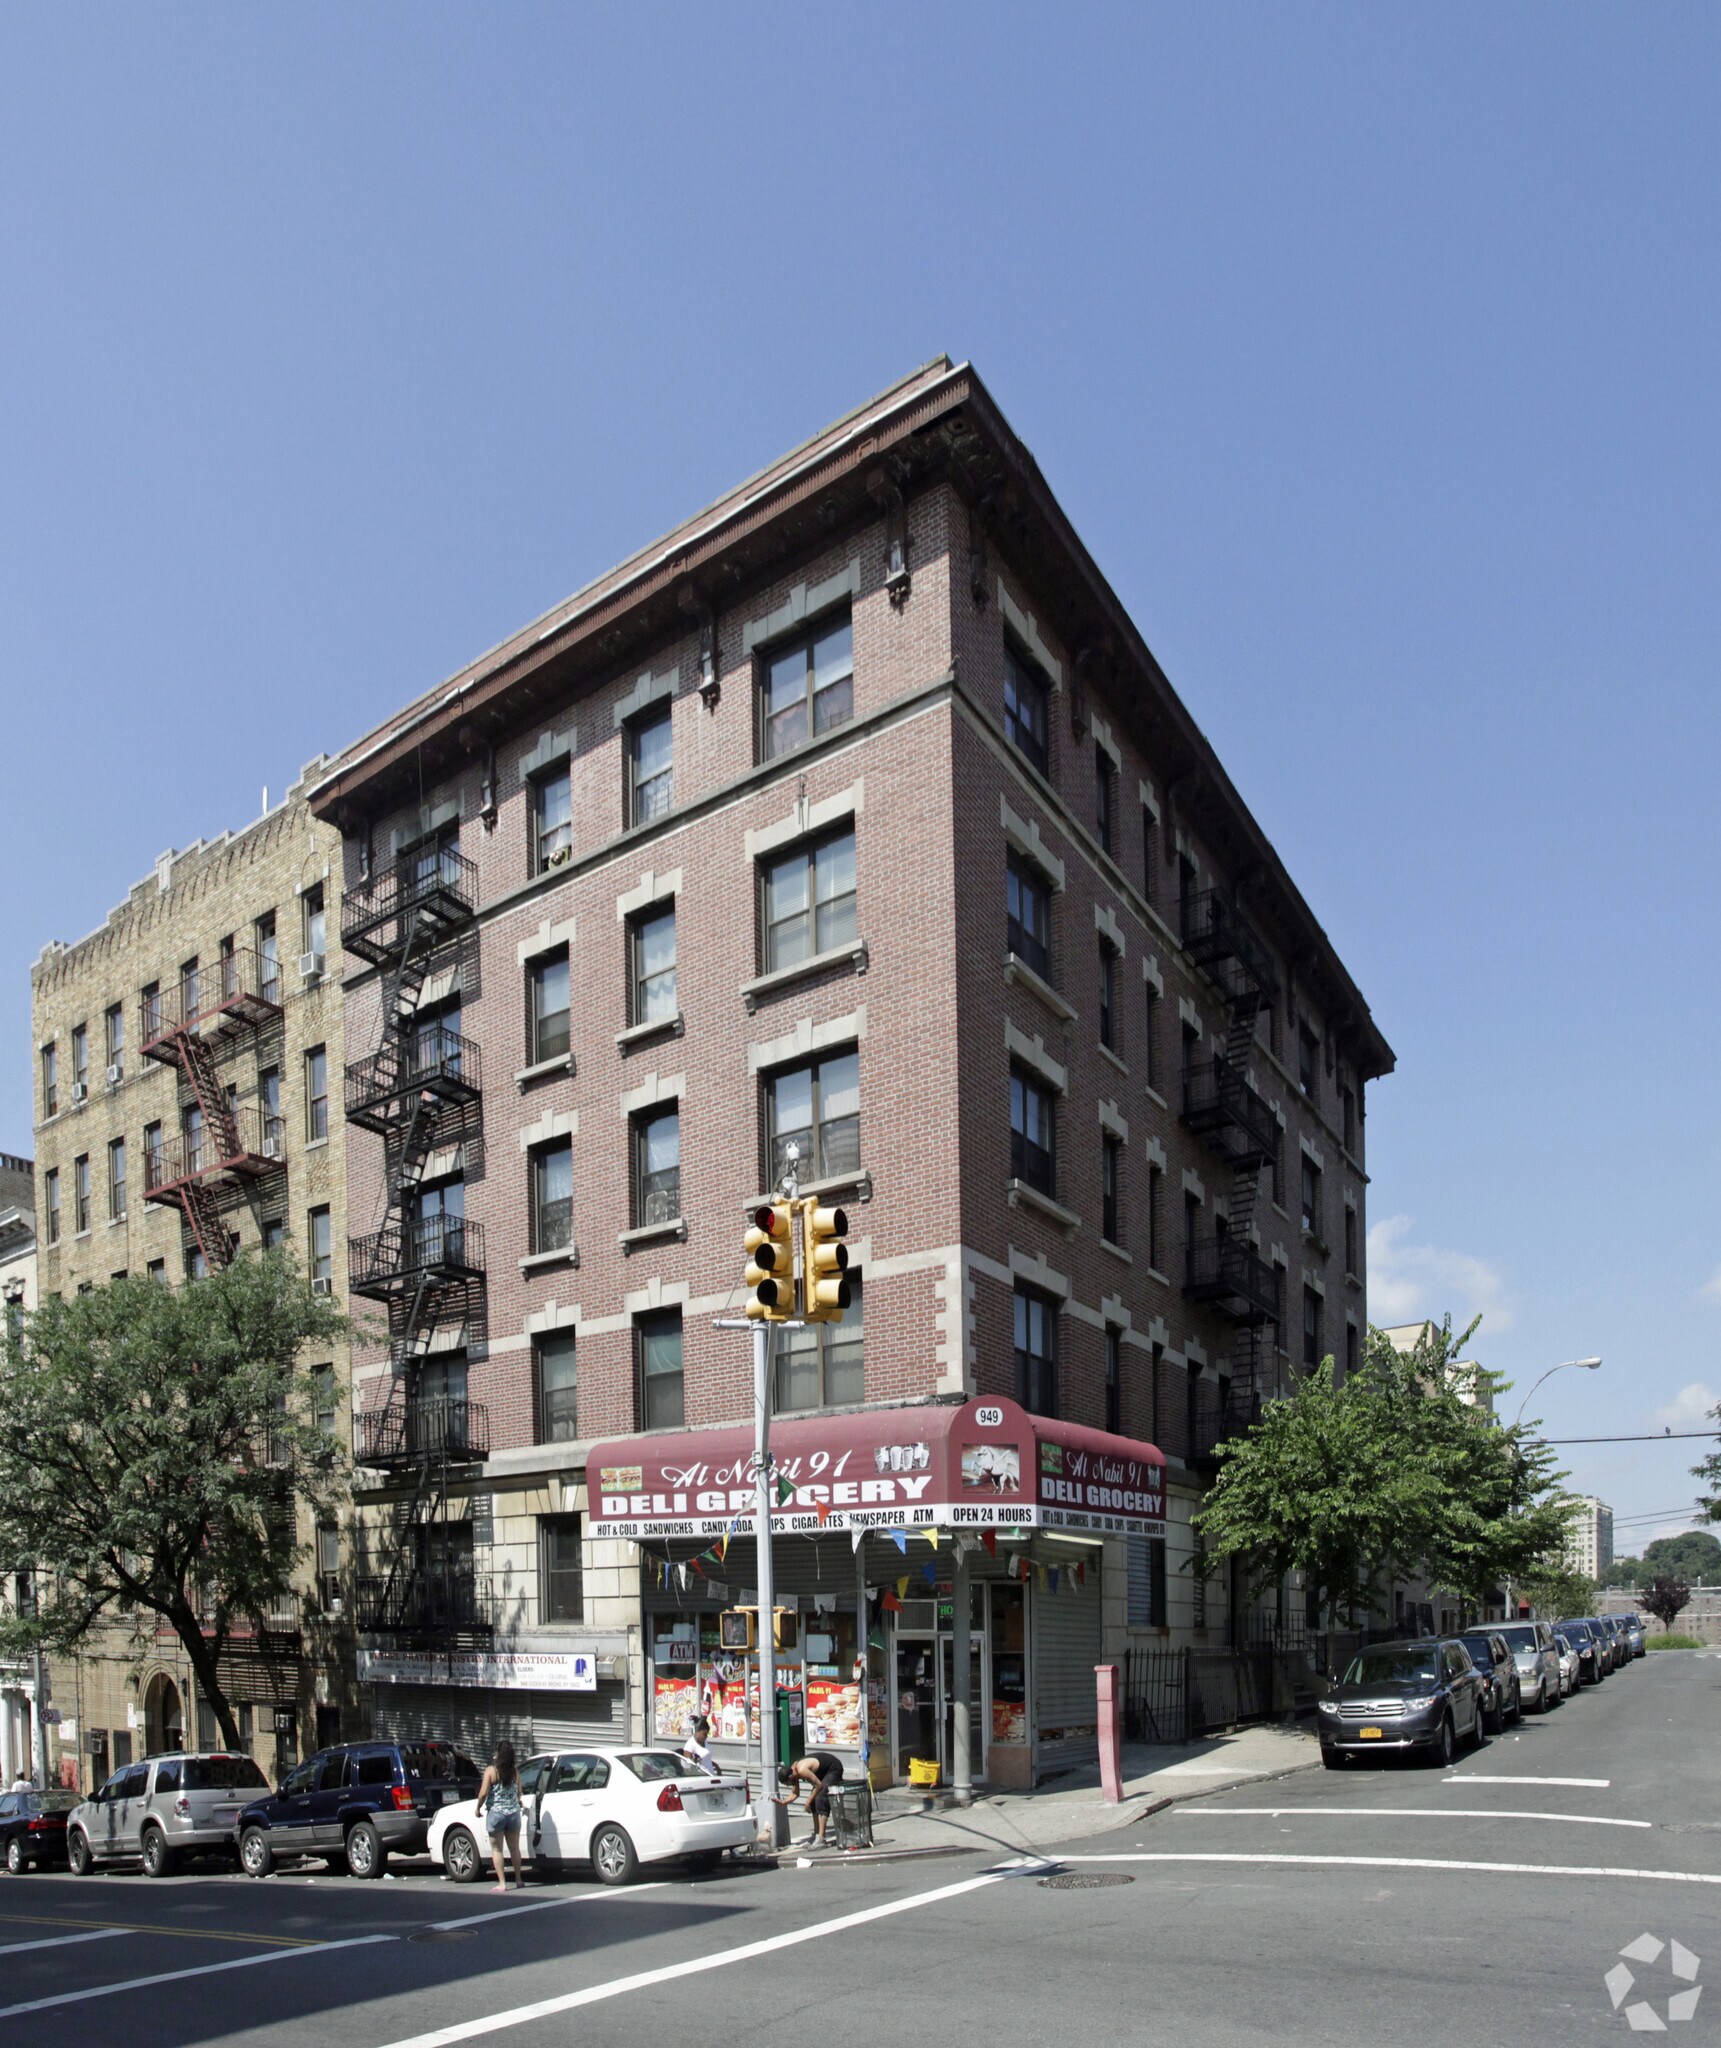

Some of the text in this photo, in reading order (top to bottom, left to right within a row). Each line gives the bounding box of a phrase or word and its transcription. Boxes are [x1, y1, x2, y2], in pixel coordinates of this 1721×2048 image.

[980, 1410, 999, 1424] 949
[660, 1461, 710, 1489] Al
[808, 1449, 853, 1480] 91
[1066, 1451, 1143, 1487] Al Nabil 91
[601, 1493, 687, 1516] DELI
[1041, 1477, 1163, 1514] DELI GROCERY
[597, 1524, 611, 1536] HOT
[619, 1523, 638, 1535] COLD
[643, 1521, 694, 1535] SANDWICHES
[701, 1520, 728, 1534] CANDY
[913, 1508, 934, 1522] ATM
[953, 1507, 1032, 1522] OPEN 24 HOURS
[370, 1652, 568, 1665] BETHEL PRAYER MINISTRY INTERNATIONAL
[671, 1644, 694, 1659] ATM
[808, 1686, 825, 1695] NABIL
